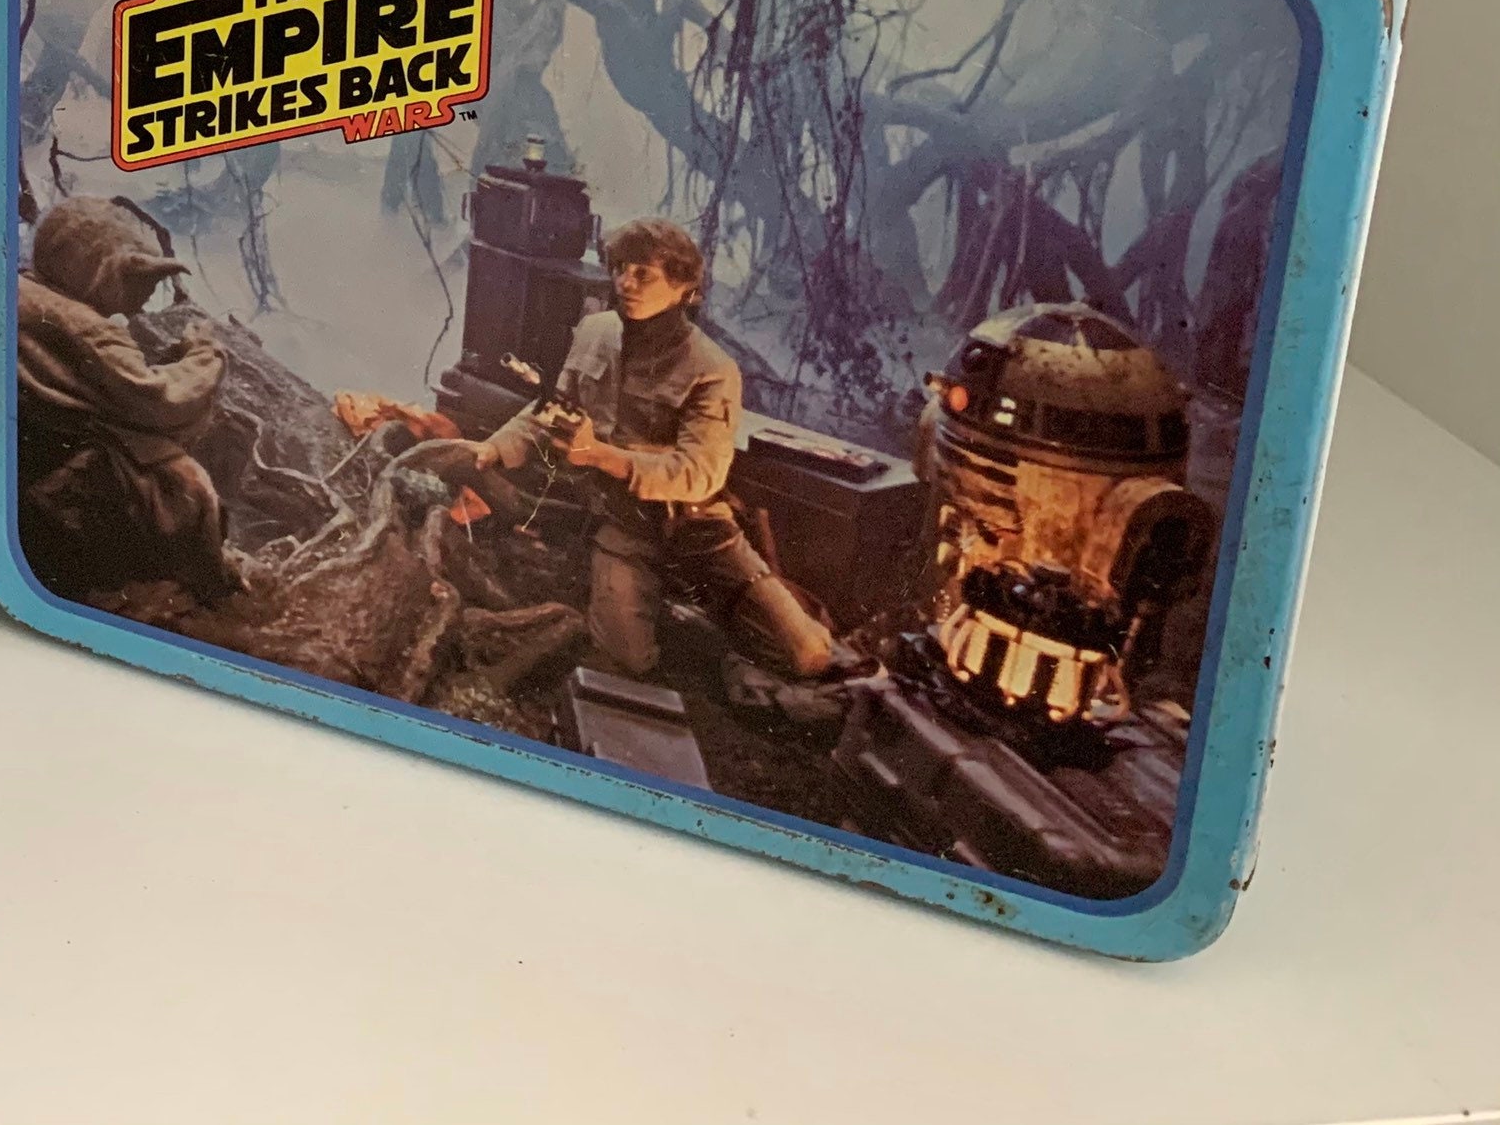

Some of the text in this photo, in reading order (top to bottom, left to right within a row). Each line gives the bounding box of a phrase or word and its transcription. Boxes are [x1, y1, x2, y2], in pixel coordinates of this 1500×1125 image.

[126, 42, 472, 156] STRIKES BACK
[342, 99, 456, 145] WARS
